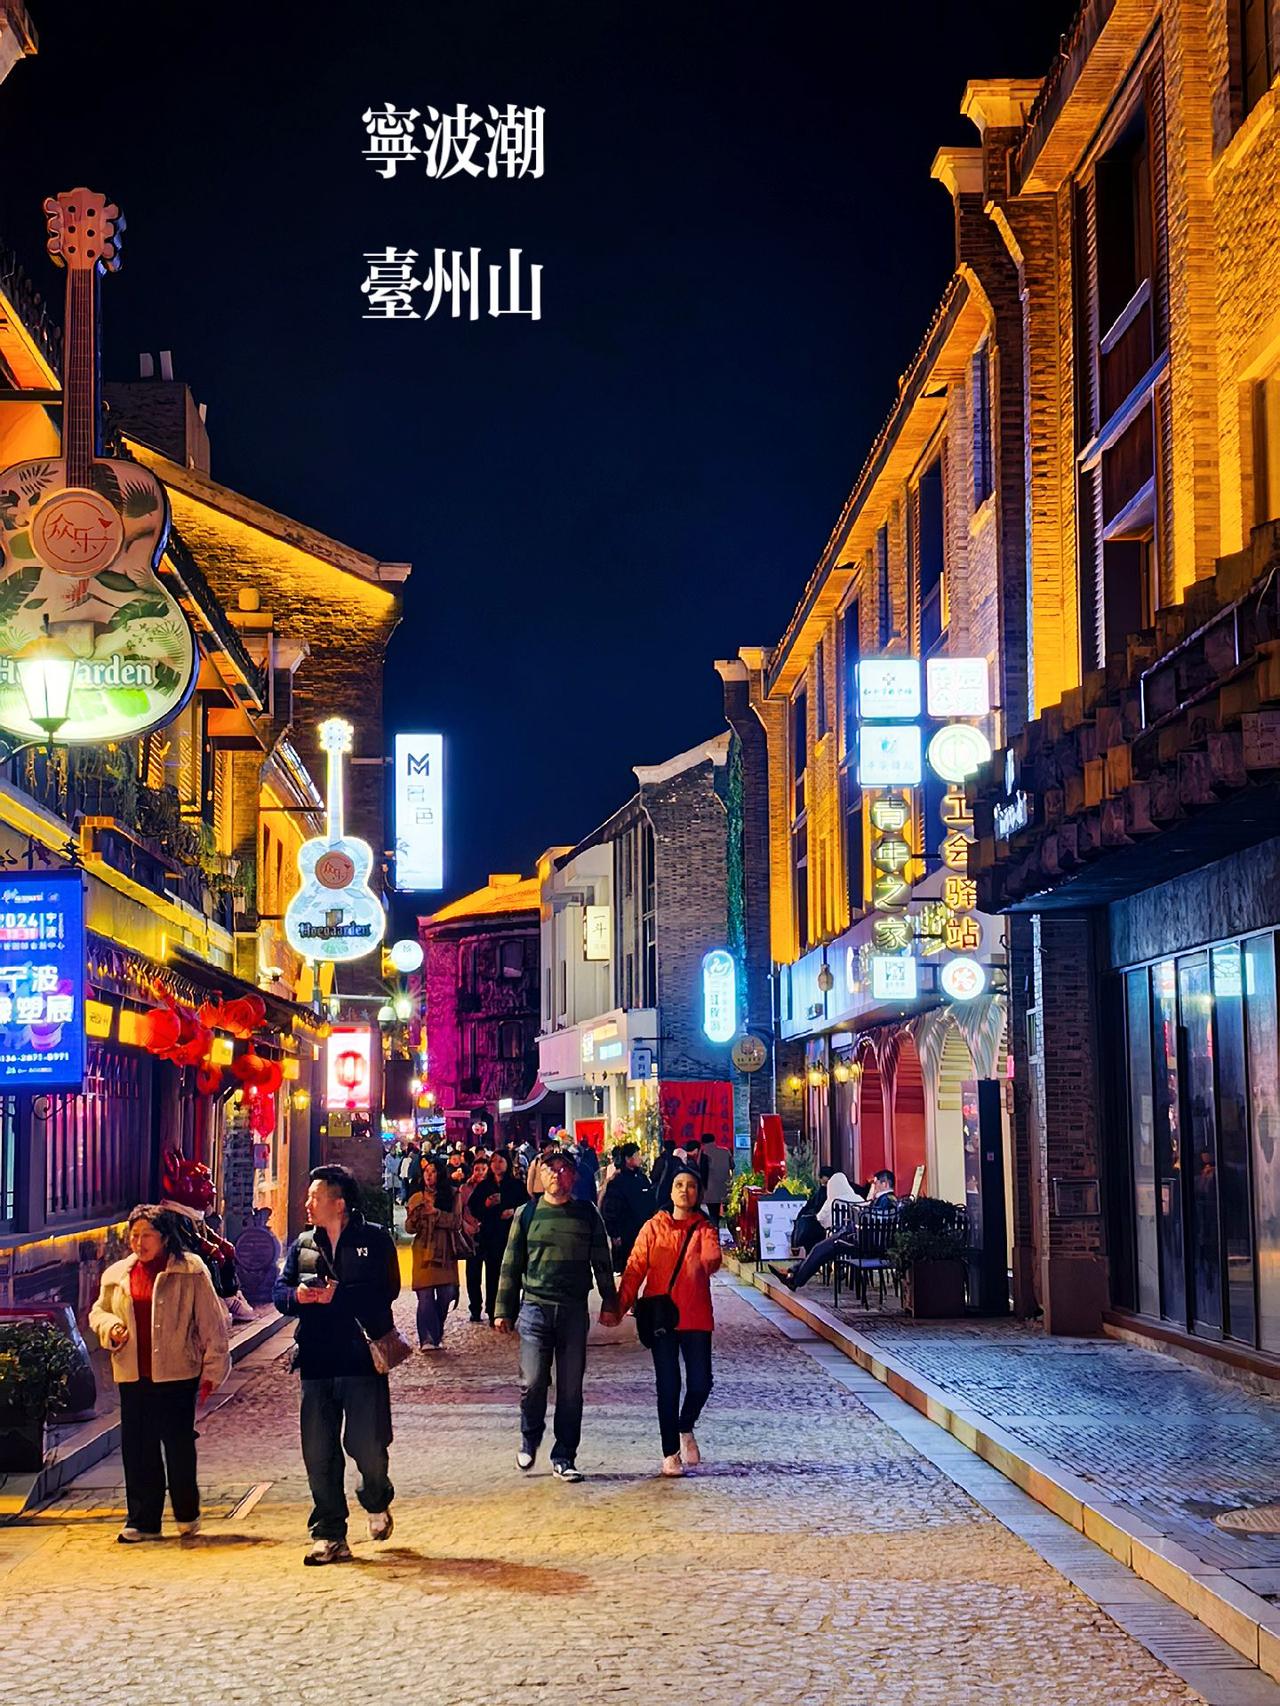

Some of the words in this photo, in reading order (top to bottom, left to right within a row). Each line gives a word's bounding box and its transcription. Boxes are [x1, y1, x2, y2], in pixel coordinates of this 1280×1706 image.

[0, 655, 153, 688] Harden
[874, 796, 908, 950] 青年之家
[946, 796, 979, 950] 工会驿站
[299, 922, 371, 940] Hoegaarden
[0, 965, 58, 993] 宁波
